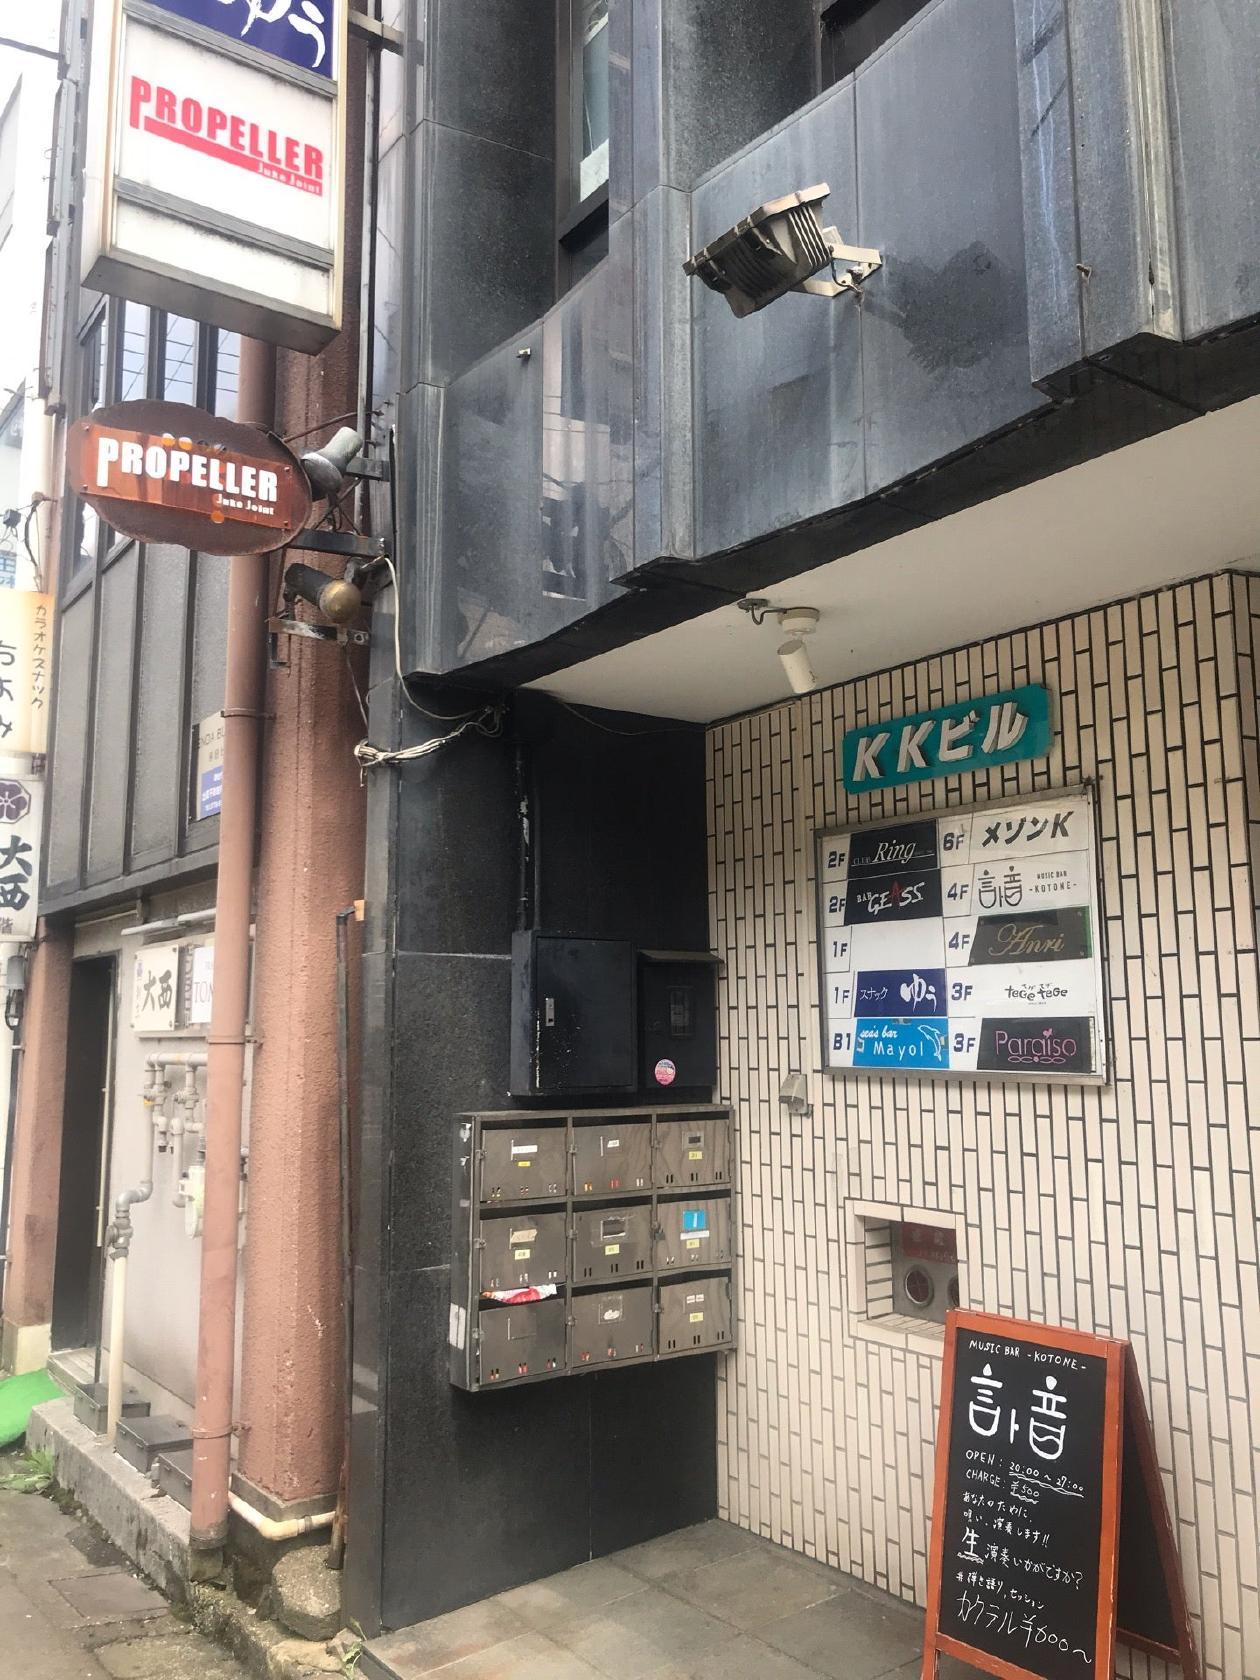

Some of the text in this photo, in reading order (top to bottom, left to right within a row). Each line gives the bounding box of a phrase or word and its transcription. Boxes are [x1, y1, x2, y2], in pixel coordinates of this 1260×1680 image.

[129, 75, 324, 181] PROPELLER
[96, 437, 278, 502] PROPELLER
[31, 604, 47, 710] カラオケスナック
[852, 701, 1029, 782] KKビル
[981, 811, 1075, 848] メゾンK
[942, 832, 965, 851] 6F
[827, 850, 846, 869] 2F
[872, 839, 916, 864] Ring
[0, 834, 33, 911] 大西
[946, 882, 970, 901] 4F
[828, 895, 846, 914] 2F
[833, 941, 848, 957] 1F
[948, 931, 971, 950] 4F
[834, 986, 850, 1004] 1F
[859, 973, 937, 1014] スナック ゆう
[951, 982, 973, 1001] 3F
[832, 1032, 851, 1051] B1
[881, 1025, 898, 1039] bar
[873, 1041, 924, 1061] Mayol
[953, 1032, 976, 1053] 3F
[994, 1028, 1077, 1057] Paraiso
[968, 1340, 1001, 1355] MUSIC
[1004, 1346, 1020, 1358] BAR
